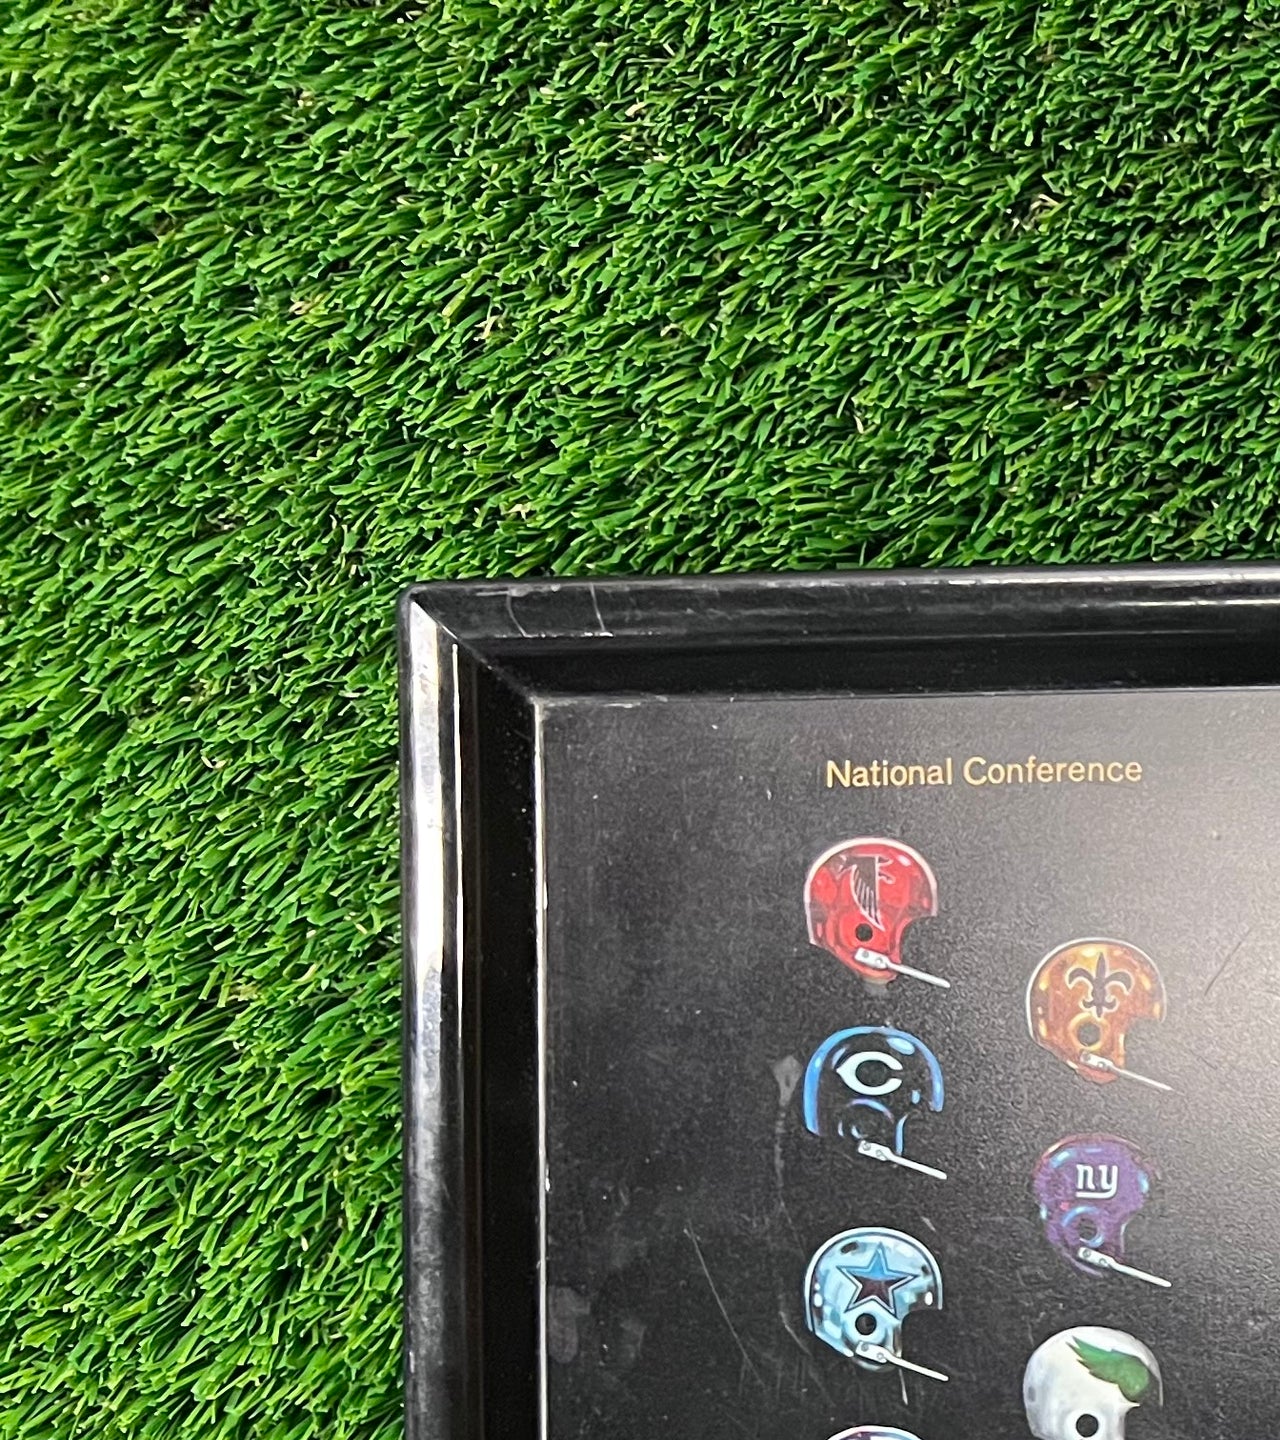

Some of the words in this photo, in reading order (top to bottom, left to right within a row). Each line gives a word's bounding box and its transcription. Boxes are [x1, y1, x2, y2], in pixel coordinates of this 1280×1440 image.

[826, 757, 952, 788] National
[963, 755, 1143, 786] Conference
[836, 1051, 903, 1095] C
